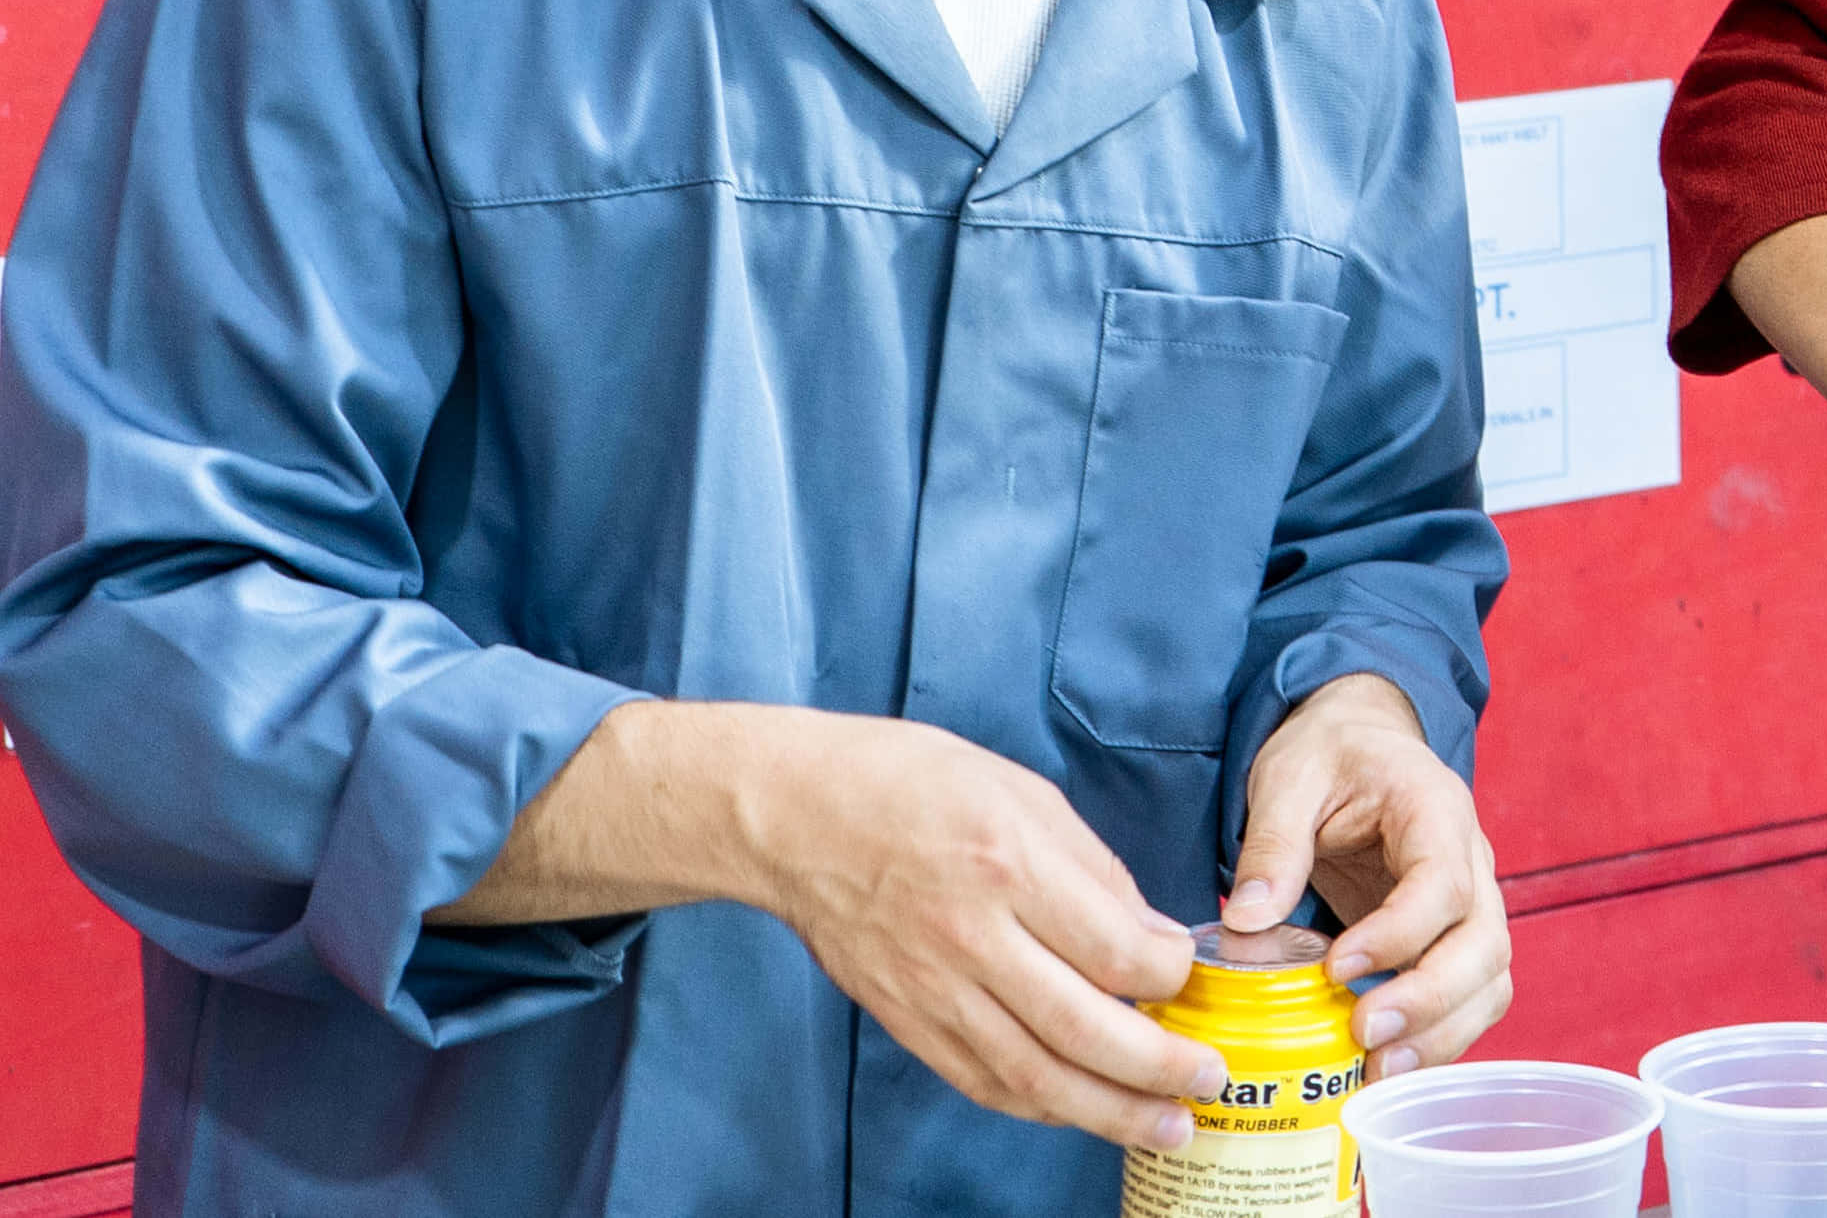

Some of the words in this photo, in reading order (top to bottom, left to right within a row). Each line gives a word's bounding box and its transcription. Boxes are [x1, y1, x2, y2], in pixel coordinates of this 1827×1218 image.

[1234, 1118, 1299, 1132] RUBBER
[1218, 1166, 1252, 1177] Series
[1243, 1195, 1292, 1206] Technical
